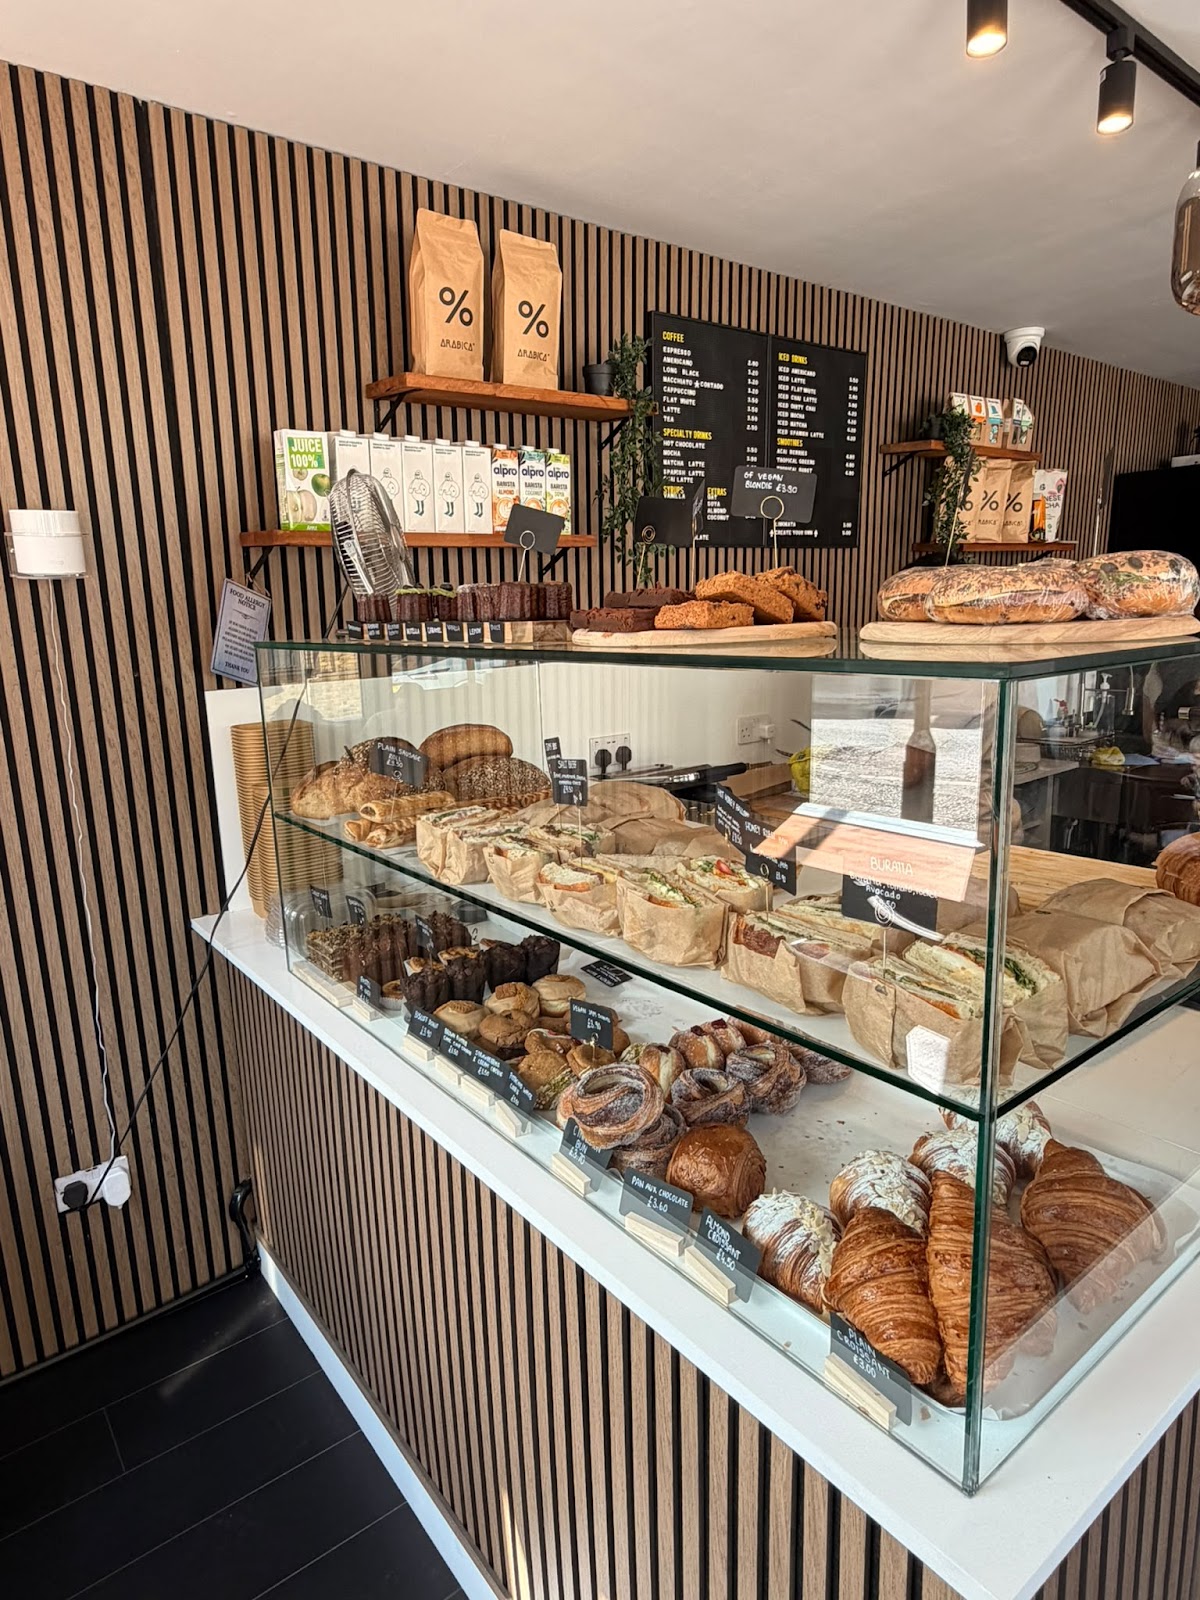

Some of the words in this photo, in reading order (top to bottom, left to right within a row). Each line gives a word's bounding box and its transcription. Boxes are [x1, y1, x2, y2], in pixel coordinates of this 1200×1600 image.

[439, 286, 474, 327] %
[518, 300, 549, 338] %
[662, 331, 685, 343] COFFEE
[440, 338, 476, 351] ARABICA
[517, 349, 550, 362] ARABICA
[662, 346, 691, 356] ESPRESSO
[662, 356, 693, 367] AMERICANO
[778, 352, 790, 361] ICED
[791, 354, 808, 365] DRINKS
[662, 366, 678, 374] LONG
[681, 368, 700, 377] BLACK
[791, 368, 816, 377] AMERICANO
[662, 376, 693, 386] MACCHIATO
[791, 377, 806, 385] LATTE
[663, 386, 696, 396] CAPPUCCINO
[662, 396, 678, 404] FLAT
[679, 397, 696, 406] WHITE
[803, 396, 818, 404] LATTE
[662, 406, 681, 414] LATTE
[790, 403, 804, 411] DIRTY
[663, 415, 675, 423] TEA
[790, 412, 805, 420] MOCHA
[790, 421, 807, 429] MATCHA
[663, 428, 692, 439] SPECIALTY
[693, 431, 712, 440] DRINKS
[291, 438, 322, 453] JUICE
[675, 441, 705, 449] CHOCOLATE
[777, 437, 803, 447] SMOOTHIES
[663, 449, 681, 457] MOCHA
[291, 454, 318, 467] 100%
[493, 463, 518, 478] alpro
[521, 465, 544, 479] alpro
[548, 467, 569, 480] alpro
[758, 472, 784, 482] VEGAN
[663, 486, 684, 494] SYRUPS
[707, 487, 727, 496] EXTRAS
[230, 588, 244, 598] FOOD
[245, 595, 266, 609] ALLERGY
[238, 599, 256, 611] NOTICE
[225, 661, 240, 672] THANK
[240, 666, 249, 674] YOU
[378, 742, 396, 753] PLAIN
[866, 885, 901, 900] Avocado
[575, 1139, 588, 1154] BUN
[631, 1175, 645, 1189] PAN
[645, 1183, 657, 1194] AUX
[658, 1188, 689, 1208] CHOCOLATE
[647, 1195, 669, 1213] £3.60
[705, 1214, 730, 1242] ALMOND
[707, 1229, 741, 1260] CROISSANT
[716, 1248, 736, 1271] £4.50
[848, 1328, 876, 1359] PLAIN
[836, 1329, 890, 1380] CROISSANT
[853, 1354, 877, 1379] £3.00
